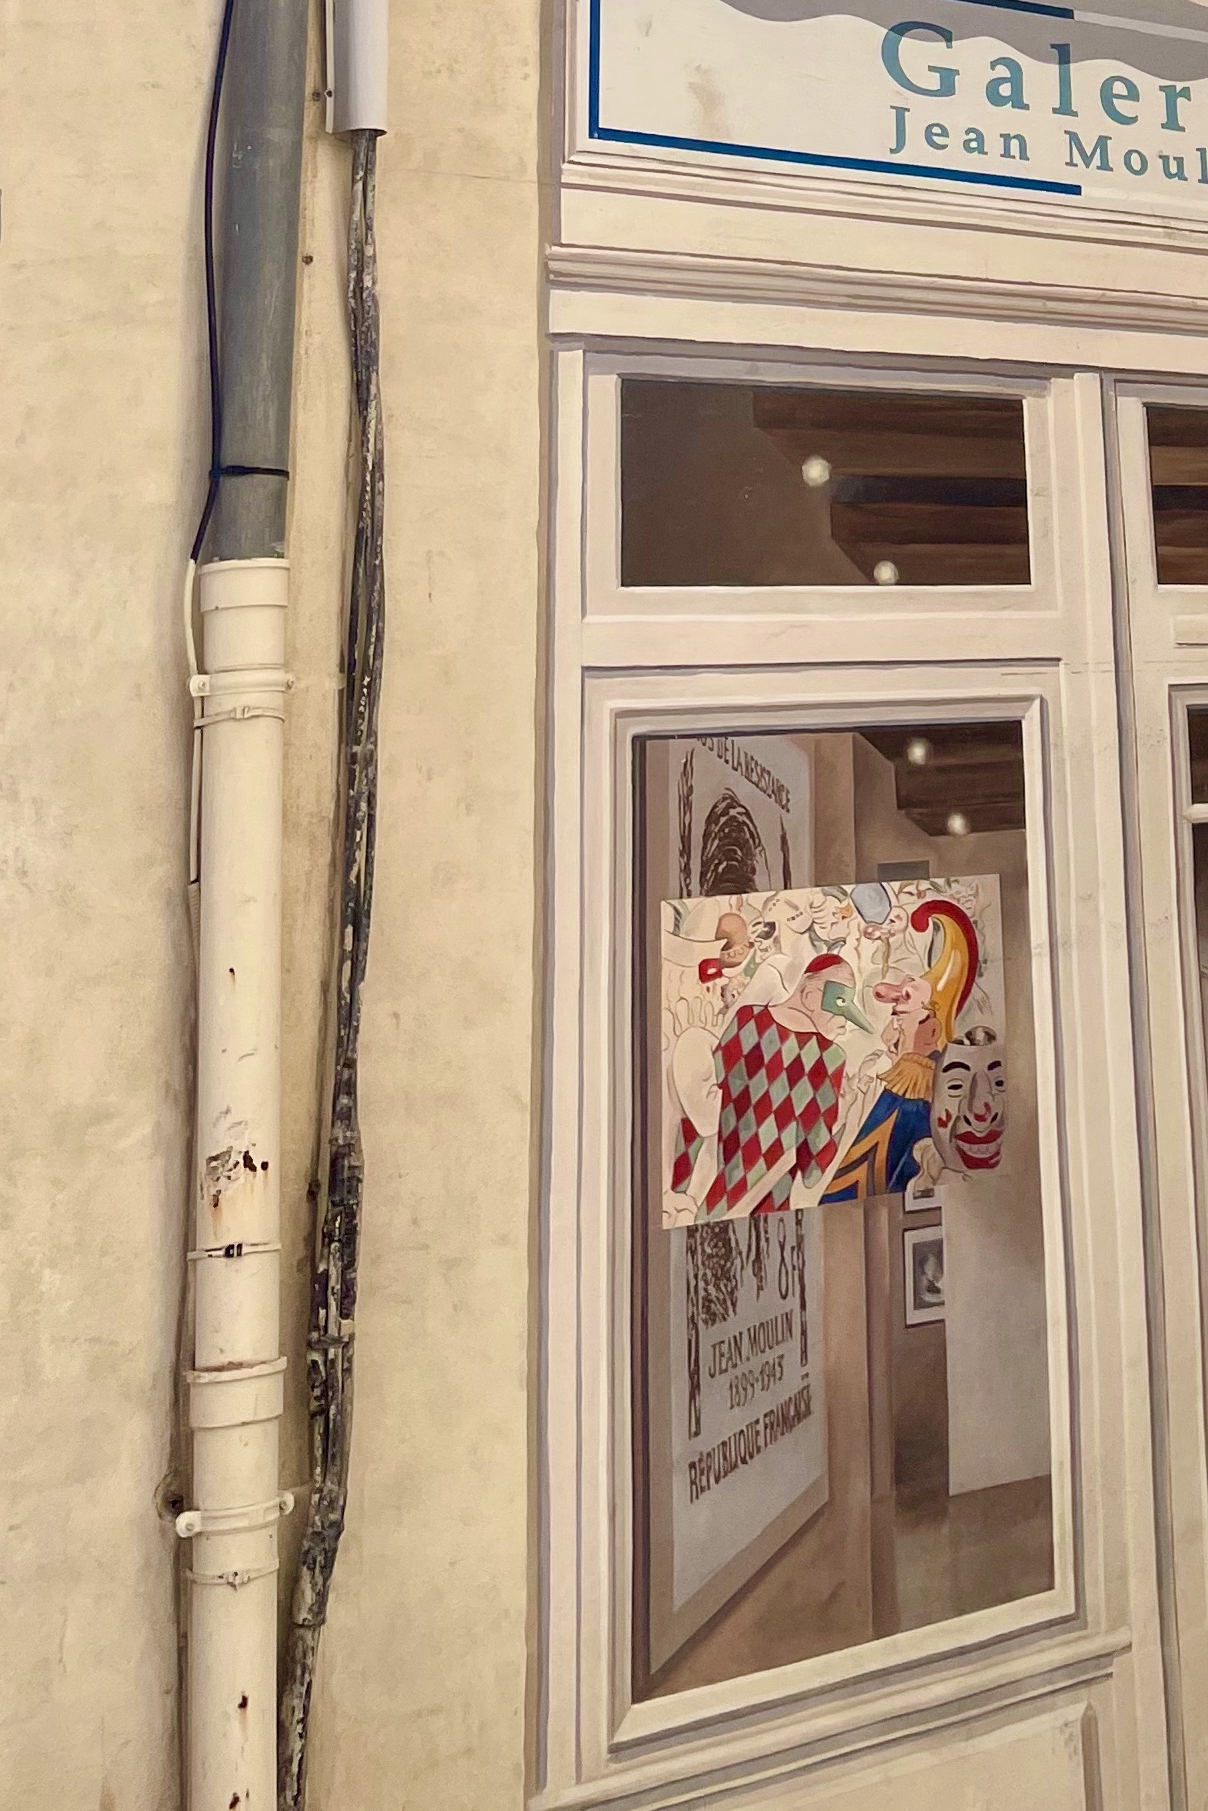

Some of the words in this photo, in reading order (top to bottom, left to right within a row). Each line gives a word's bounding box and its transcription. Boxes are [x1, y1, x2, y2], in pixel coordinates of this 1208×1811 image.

[889, 105, 1030, 161] Jean
[731, 739, 744, 777] LA
[708, 1339, 743, 1379] JEAN
[746, 1308, 793, 1362] MOULIN
